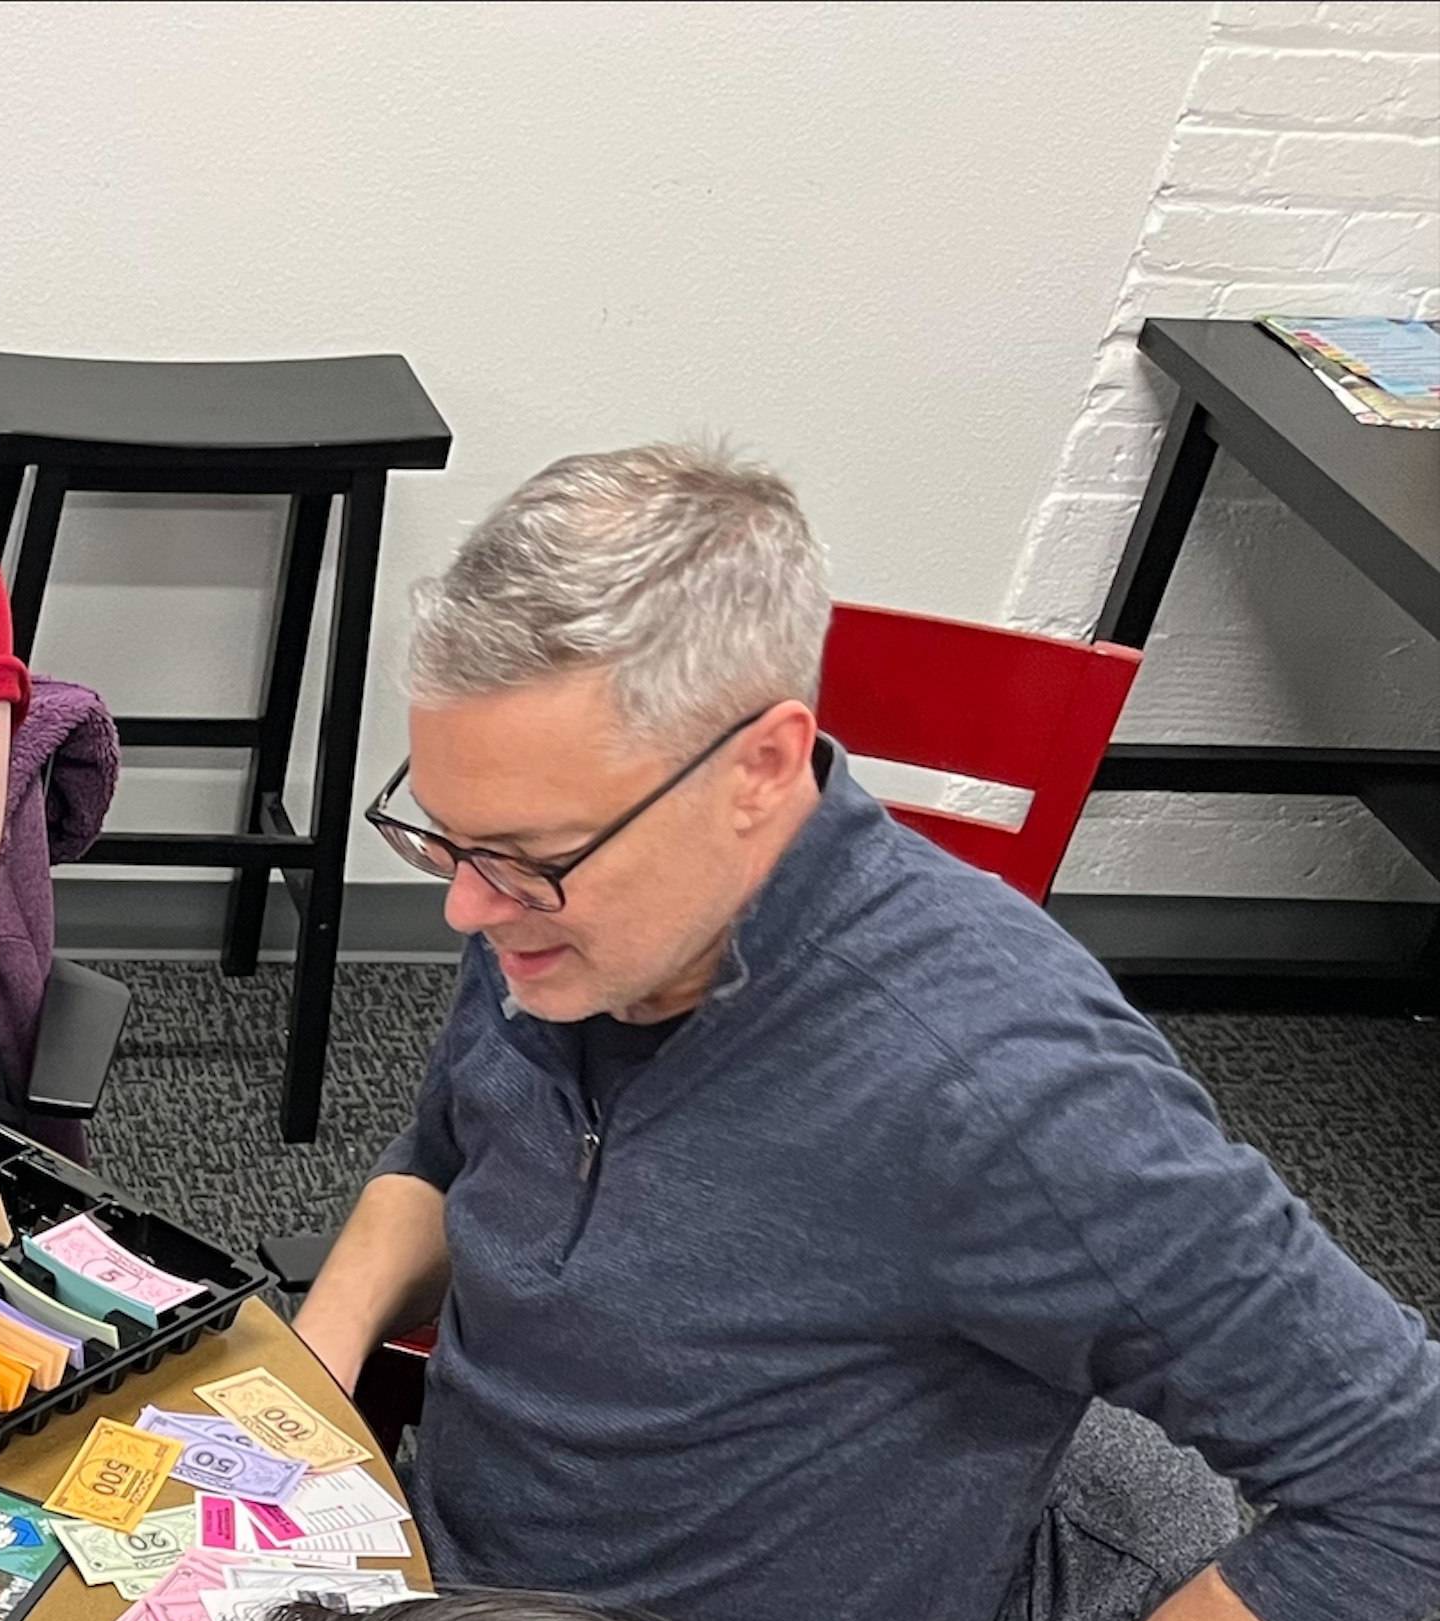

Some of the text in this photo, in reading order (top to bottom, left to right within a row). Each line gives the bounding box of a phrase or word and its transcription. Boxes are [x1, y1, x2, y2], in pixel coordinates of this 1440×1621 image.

[97, 1270, 122, 1283] 5
[264, 1408, 311, 1440] 100
[194, 1451, 238, 1474] 50
[92, 1459, 131, 1497] 500
[128, 1531, 168, 1551] 20
